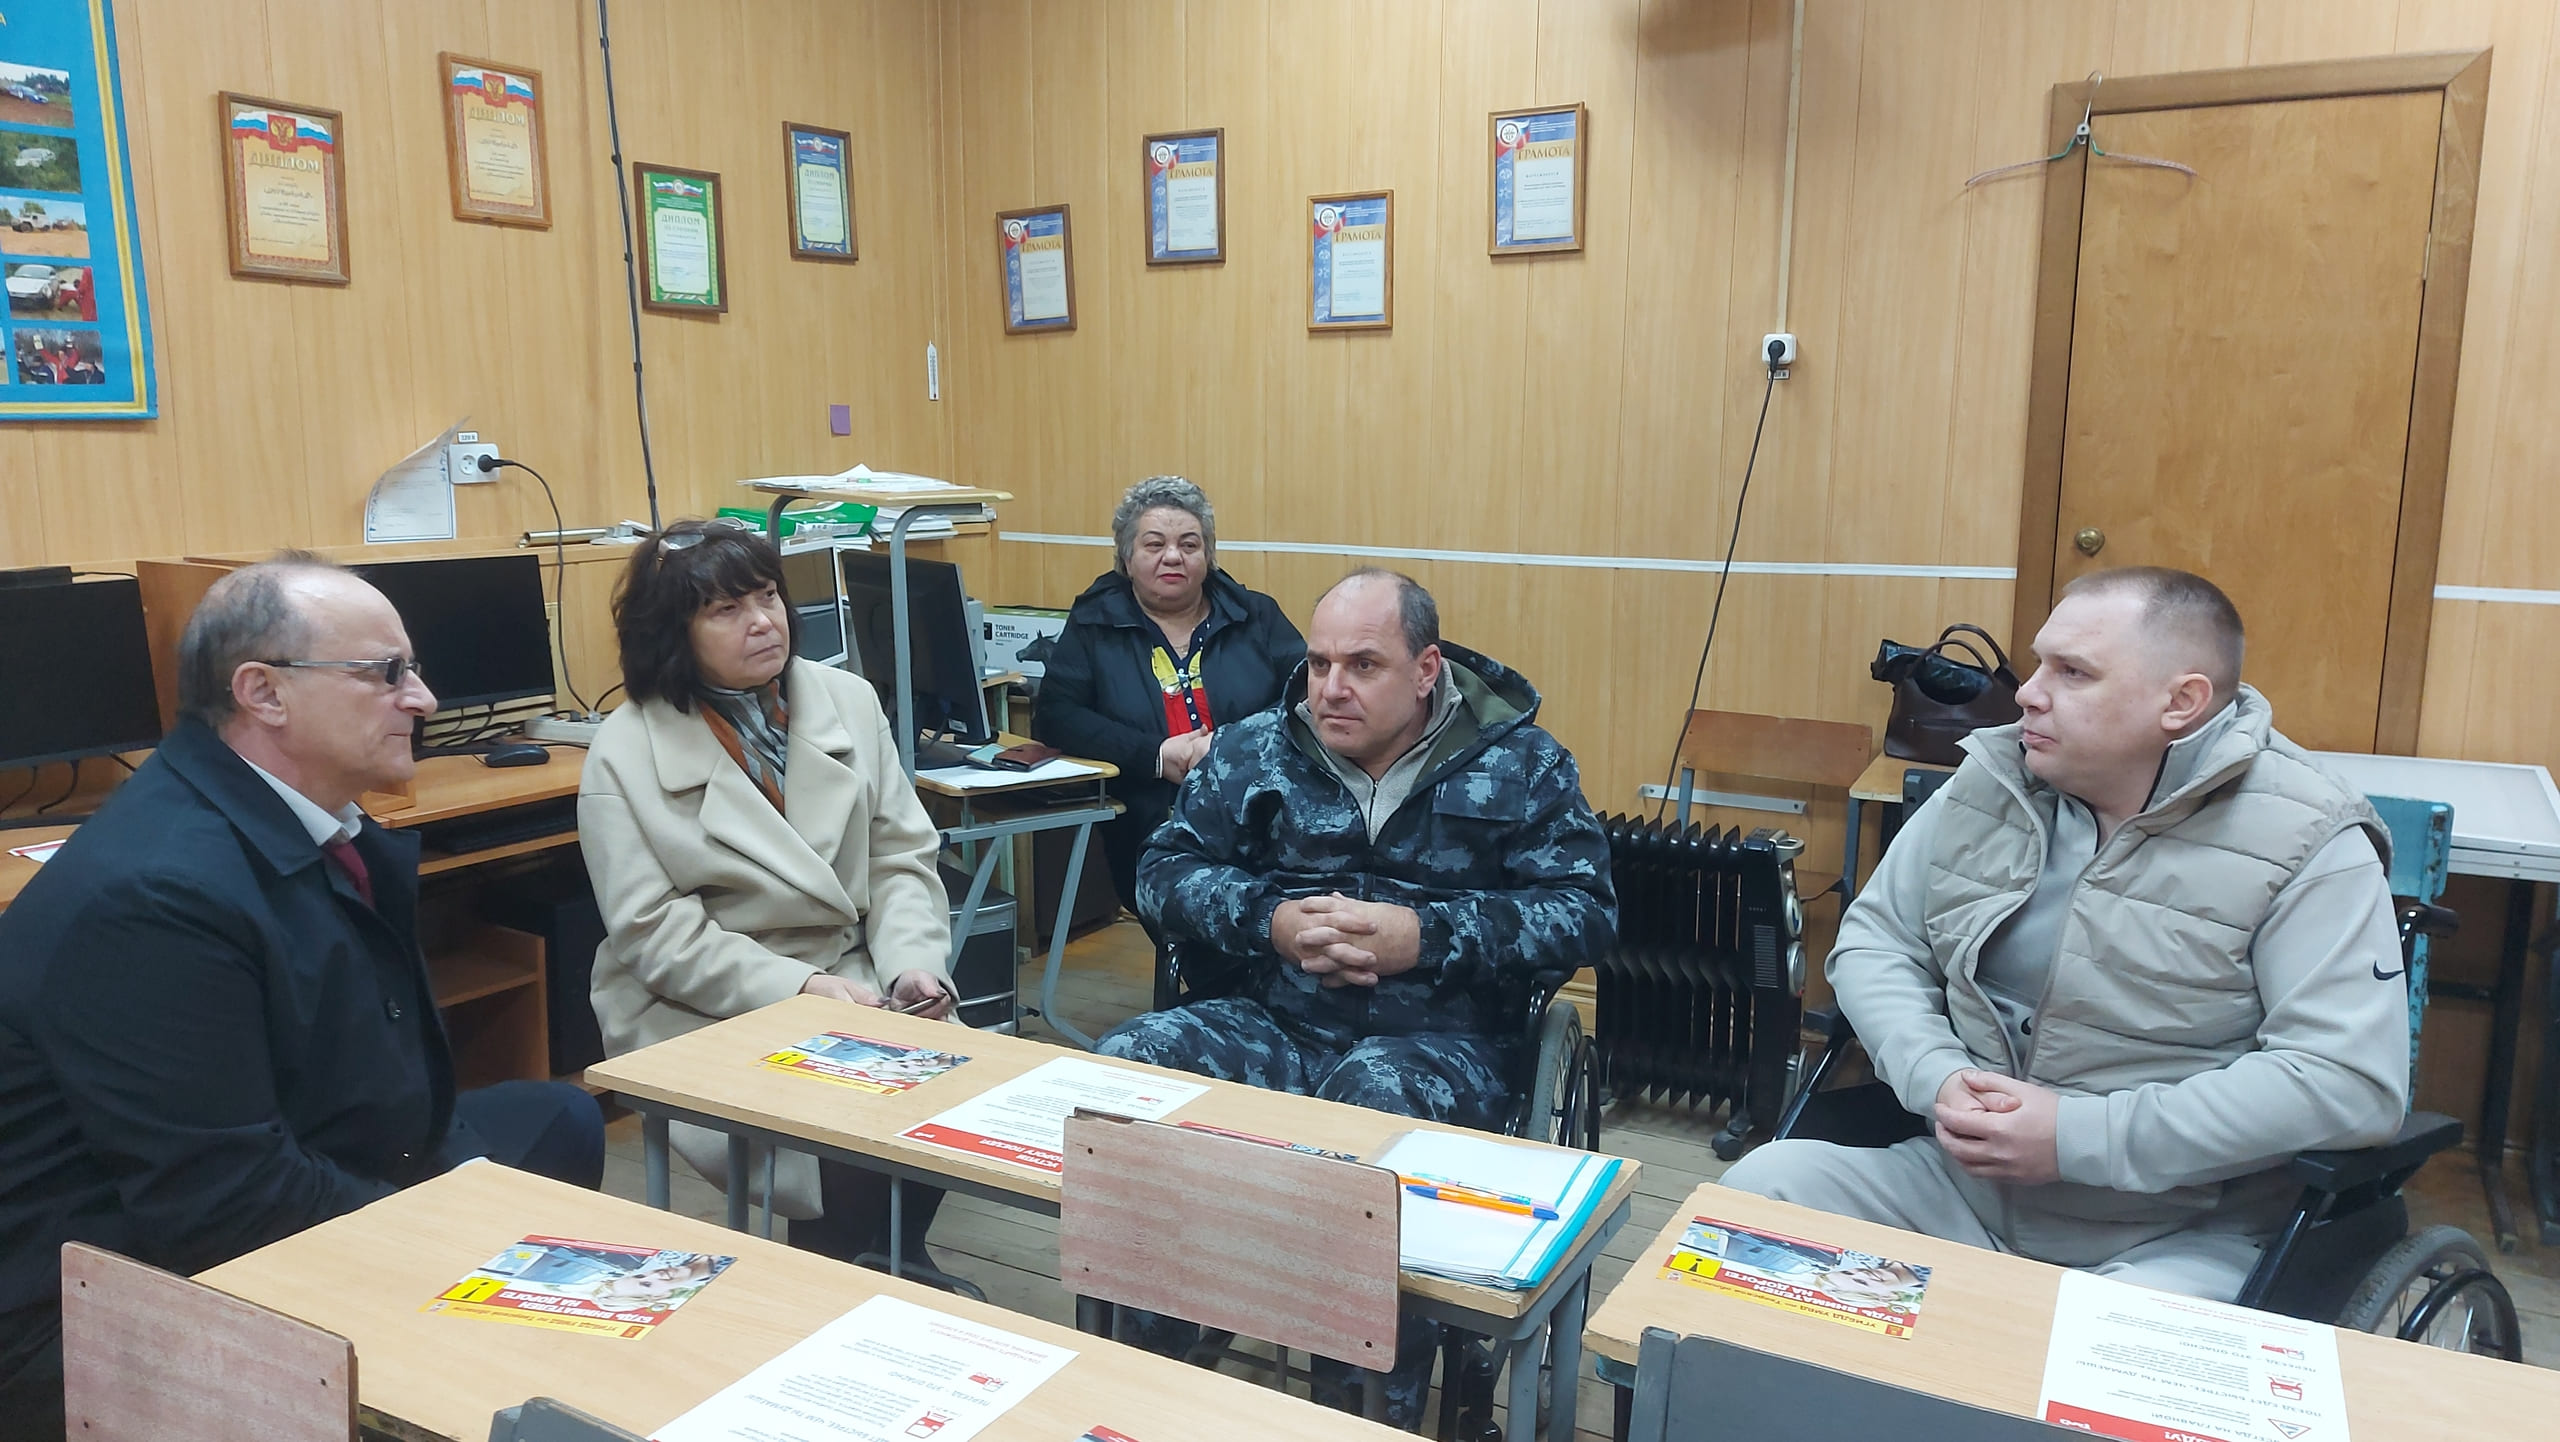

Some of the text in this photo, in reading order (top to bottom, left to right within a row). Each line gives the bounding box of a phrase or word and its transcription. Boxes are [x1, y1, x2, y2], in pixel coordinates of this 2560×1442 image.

[1517, 146, 1571, 160] ГРАМОТА
[249, 151, 320, 174] ДИПЛОМ
[1169, 167, 1213, 179] ГРАМОТА
[661, 213, 701, 225] ДИПЛОМ
[1335, 230, 1382, 243] ГРАМОТА
[995, 624, 1015, 632] TONER
[995, 631, 1029, 640] CARTRIDGE
[1723, 1270, 1813, 1296] НА ДОРОГЕ!
[557, 1298, 584, 1306] НА
[1752, 1283, 1903, 1323] БУДЬ ВНИМАТЕЛЕН
[516, 1301, 654, 1323] БУДЬ ВНИМАТЕЛЕН
